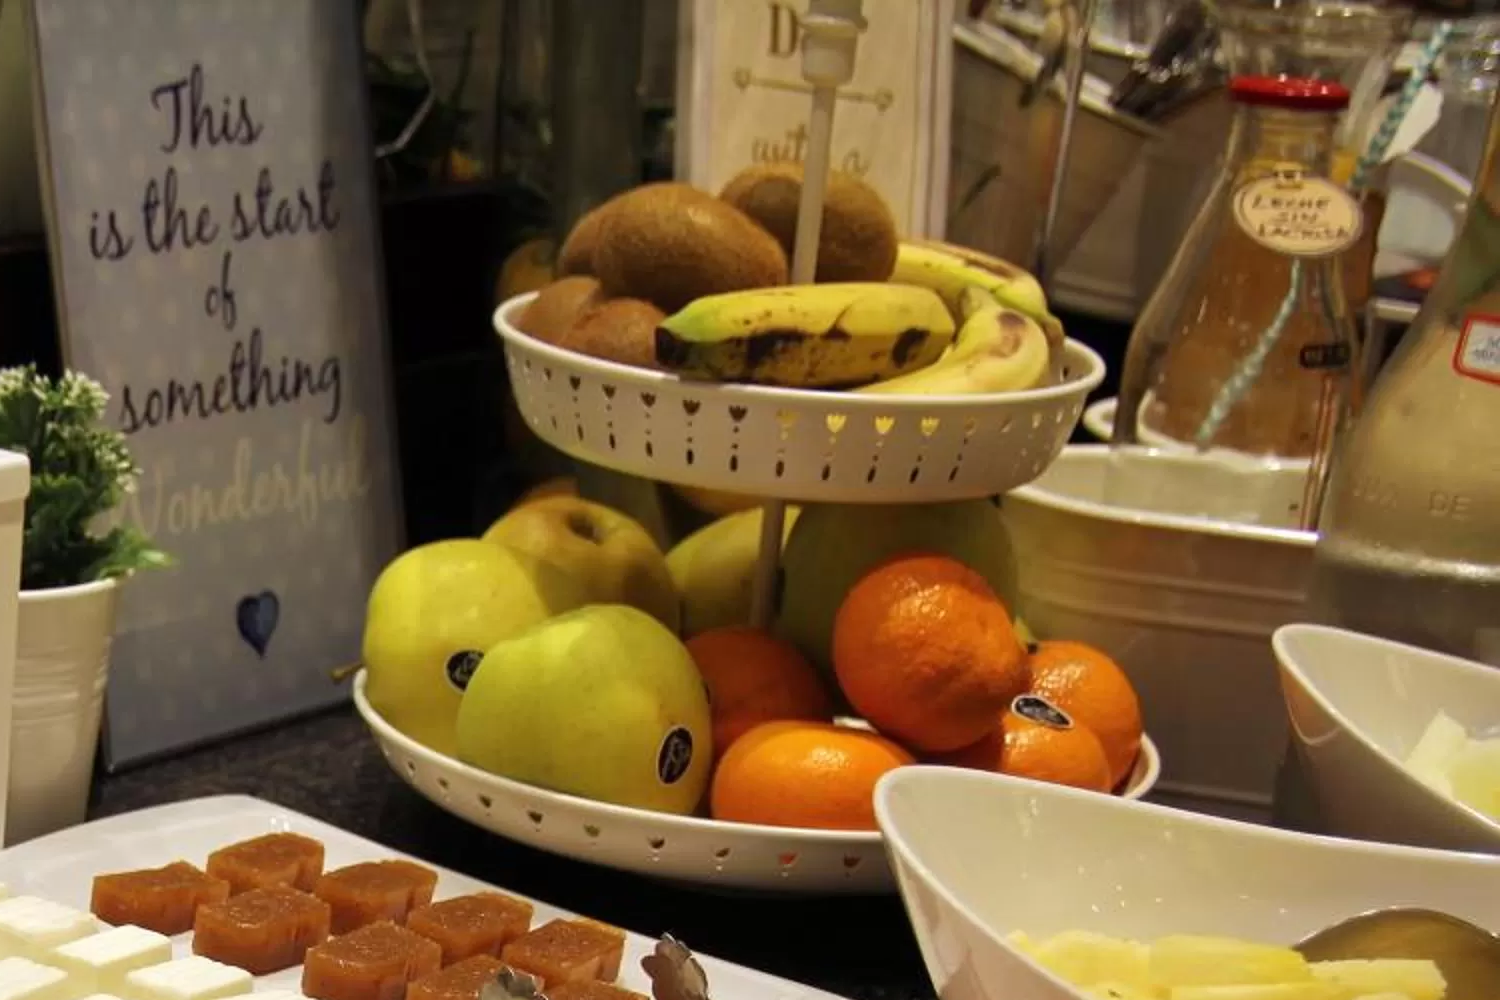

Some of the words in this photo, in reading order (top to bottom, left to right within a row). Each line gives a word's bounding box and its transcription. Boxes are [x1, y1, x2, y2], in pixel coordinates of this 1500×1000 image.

[151, 64, 263, 154] This
[89, 209, 134, 261] is
[143, 167, 220, 254] the
[230, 160, 341, 243] start
[205, 251, 237, 331] of
[119, 327, 342, 434] something
